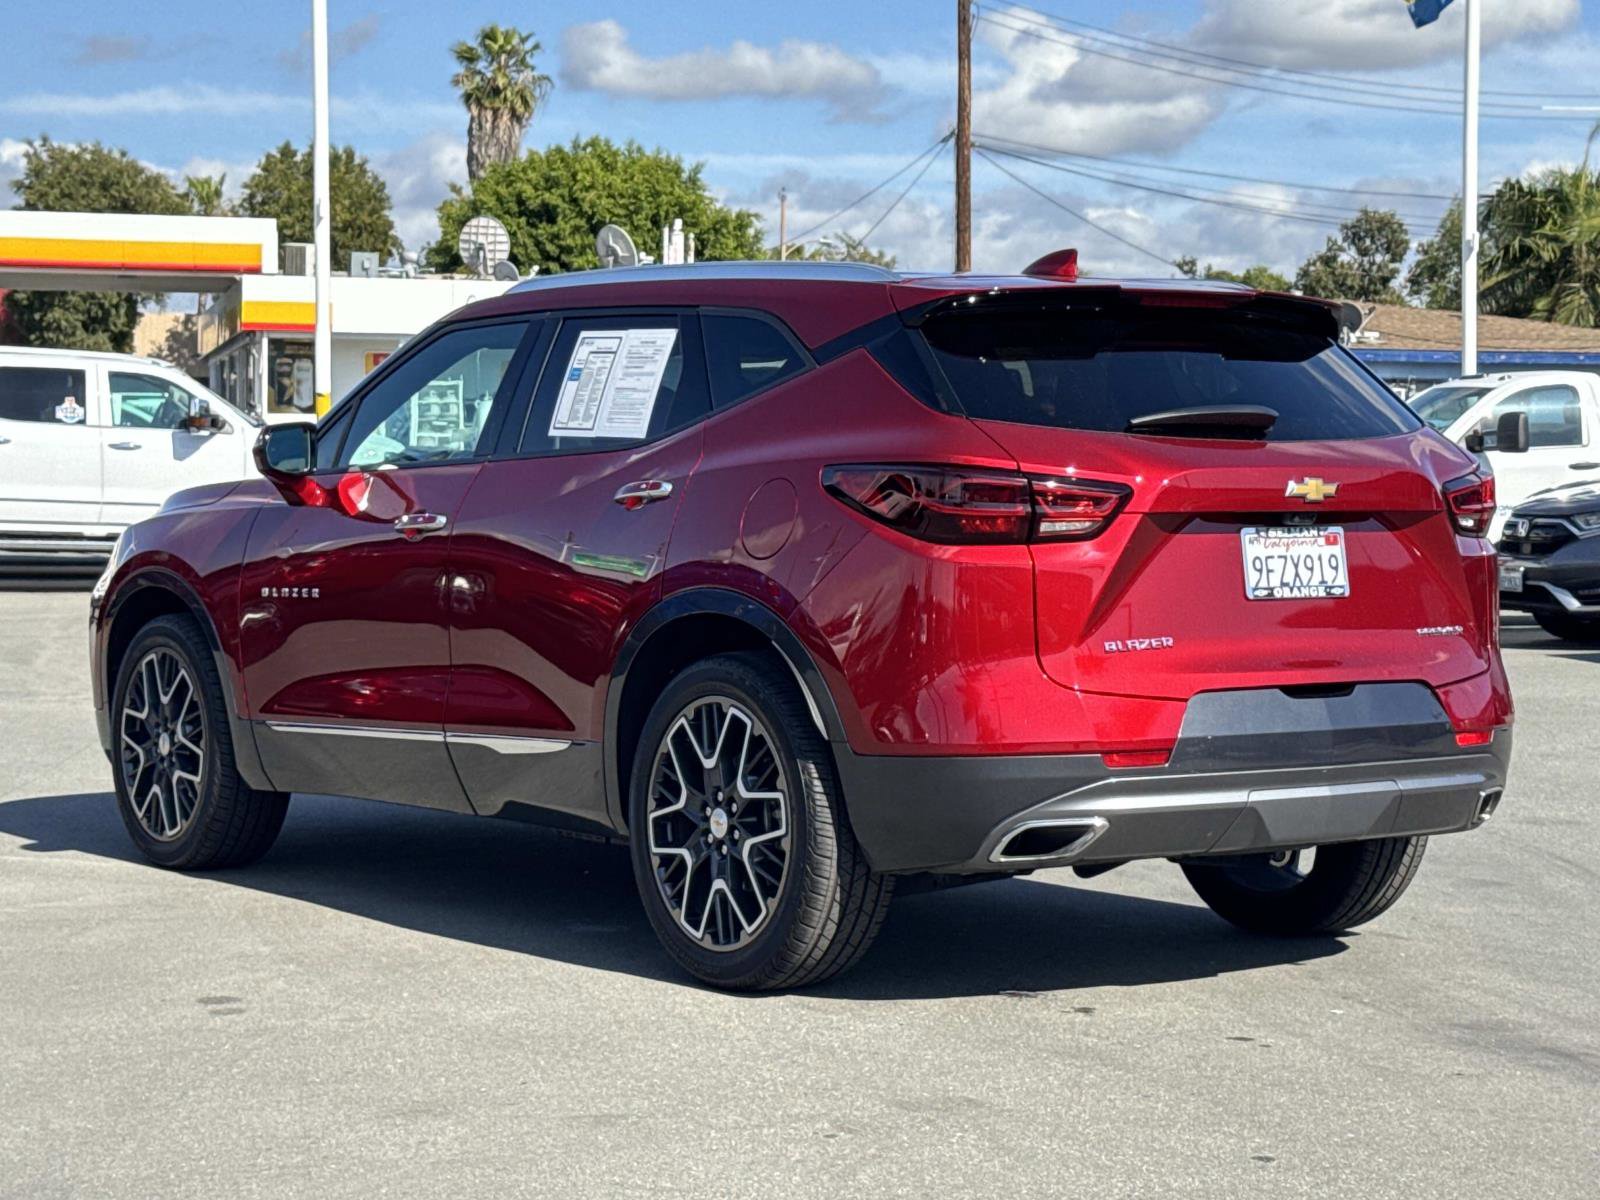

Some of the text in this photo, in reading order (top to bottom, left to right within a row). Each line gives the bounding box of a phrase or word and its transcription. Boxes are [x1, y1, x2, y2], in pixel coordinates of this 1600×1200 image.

[1252, 553, 1339, 588] 9FZX919
[261, 587, 320, 598] BLAZER
[1273, 586, 1326, 597] ORANGE
[1103, 636, 1174, 652] BLAZER
